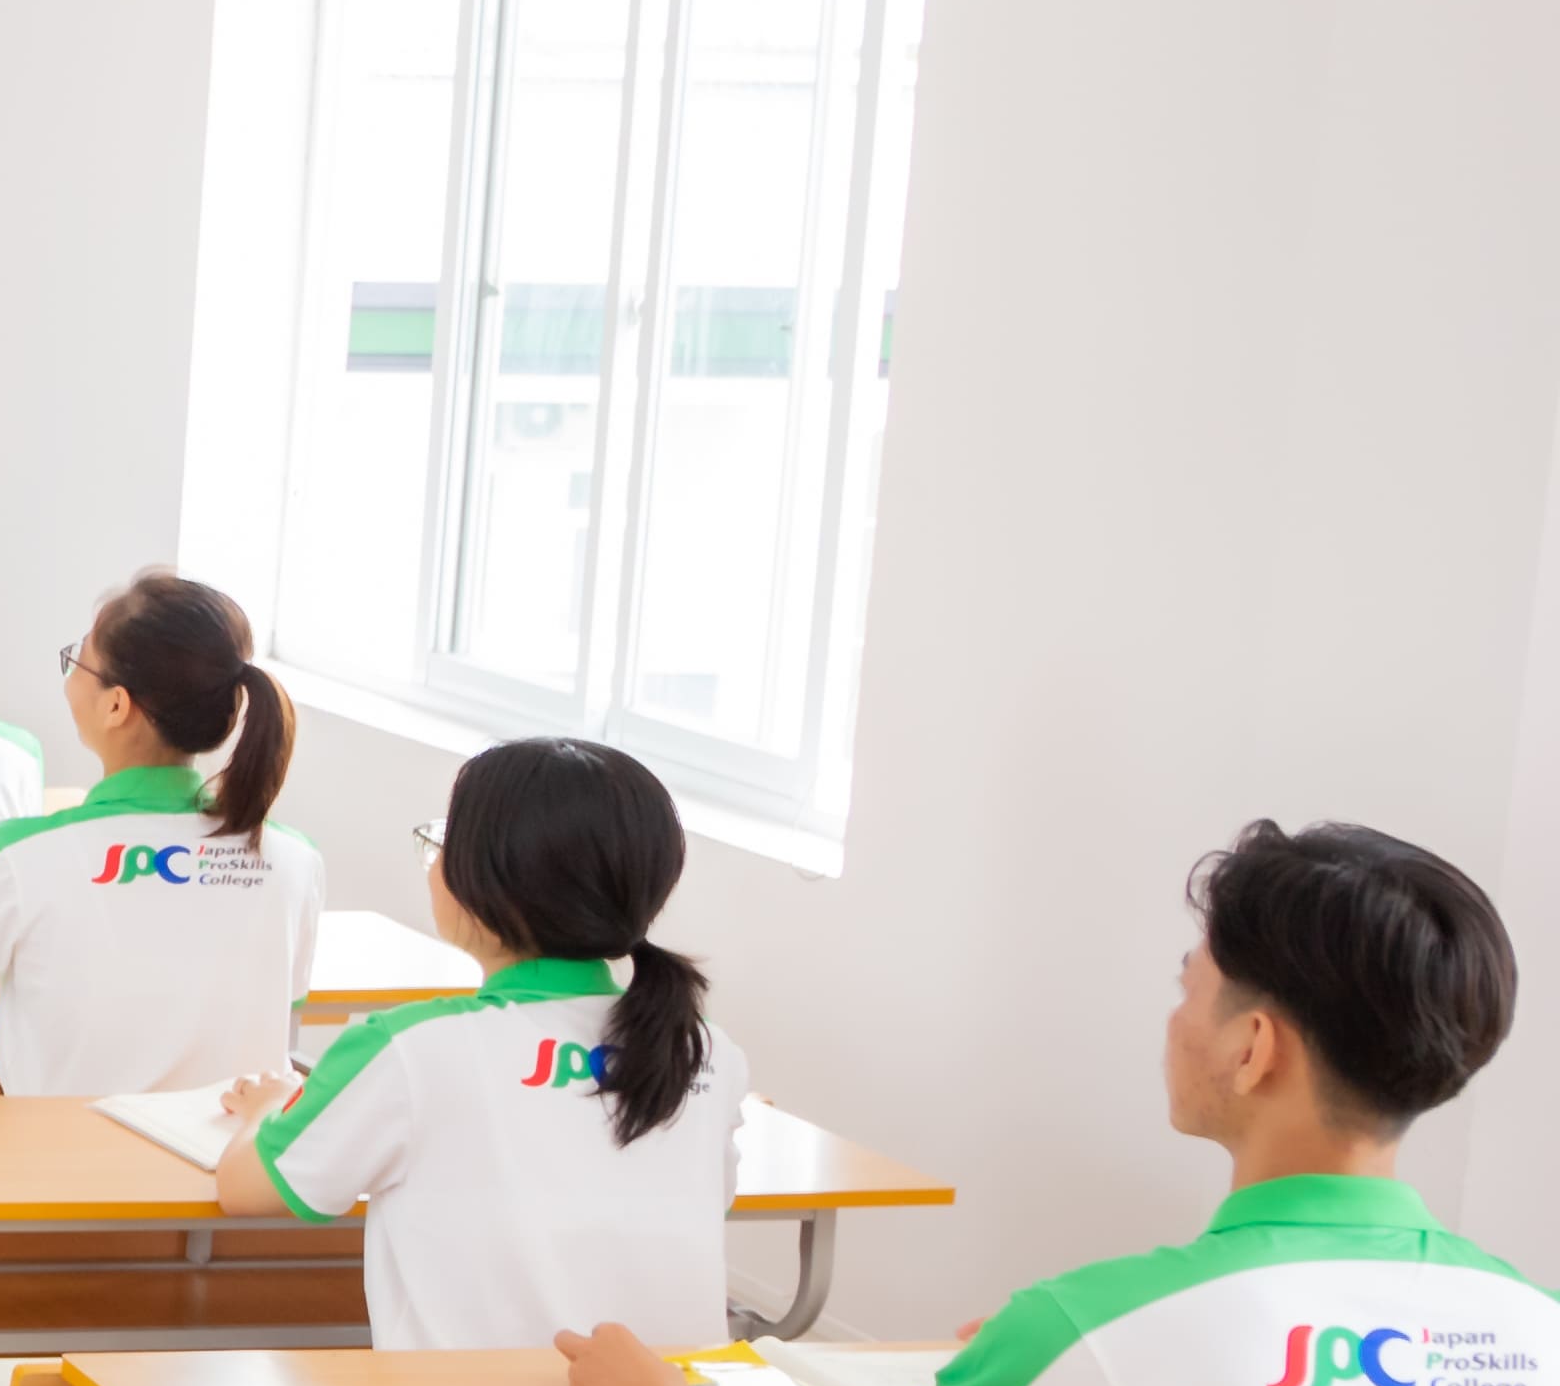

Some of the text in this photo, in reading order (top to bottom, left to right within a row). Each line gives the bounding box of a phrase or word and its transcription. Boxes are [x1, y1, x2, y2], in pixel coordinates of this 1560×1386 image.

[196, 844, 250, 858] Japan
[91, 843, 192, 885] JPC
[198, 859, 273, 871] ProSkills
[199, 873, 264, 888] College
[1421, 1327, 1496, 1348] Japan
[1426, 1351, 1539, 1371] ProSkills
